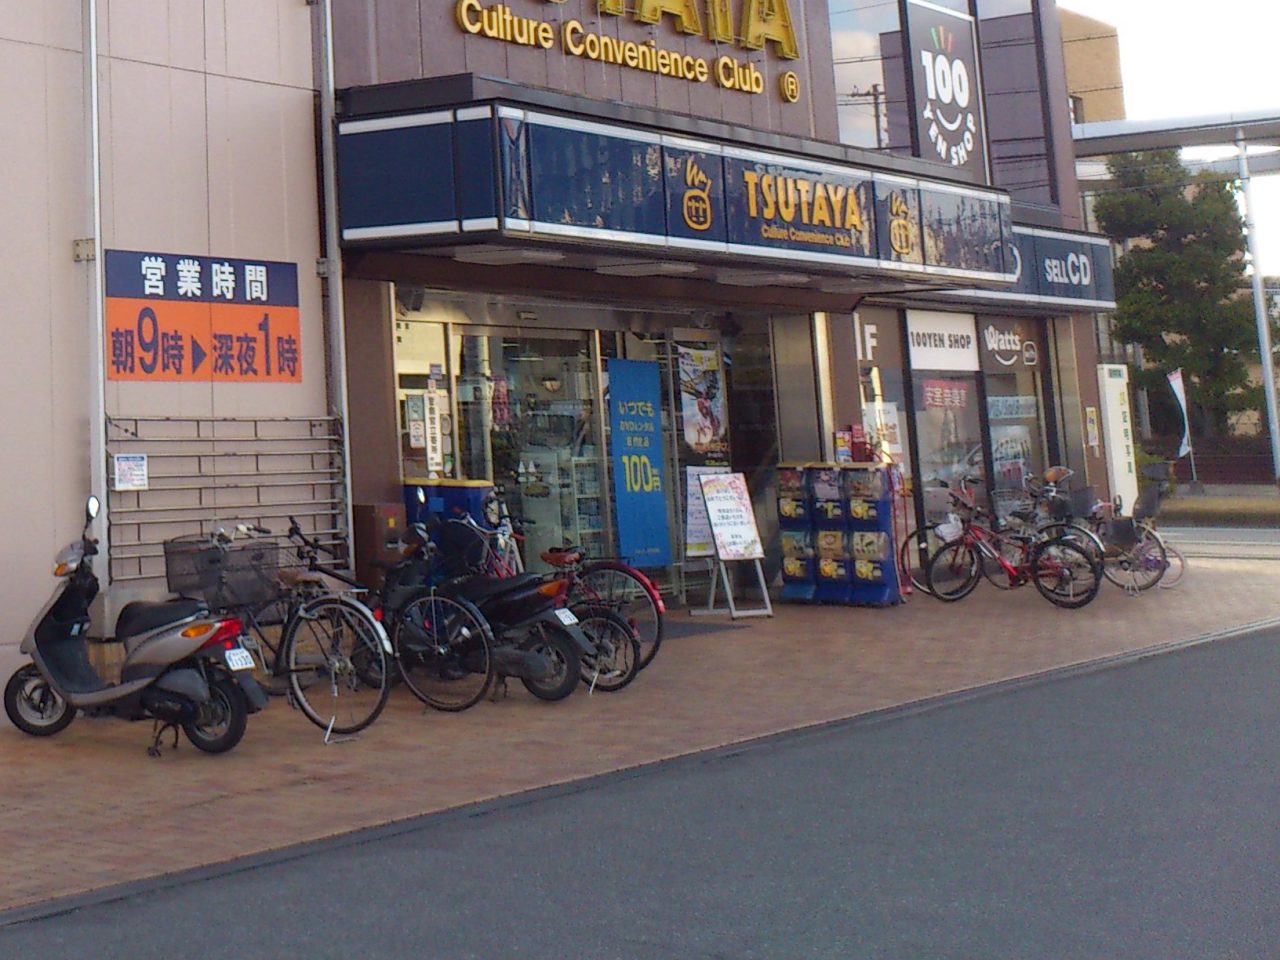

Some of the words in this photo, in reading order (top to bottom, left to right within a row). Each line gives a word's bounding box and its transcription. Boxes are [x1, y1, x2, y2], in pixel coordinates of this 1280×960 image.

[563, 19, 708, 83] Convenience
[716, 55, 764, 94] Club
[921, 50, 969, 108] 100
[923, 102, 947, 159] YEN
[951, 113, 975, 166] SHOP
[744, 169, 863, 231] TSUTAYA
[141, 256, 268, 301] 営業時間
[948, 333, 972, 349] SHOP
[984, 325, 1020, 351] Watts
[618, 401, 654, 417] いつでも
